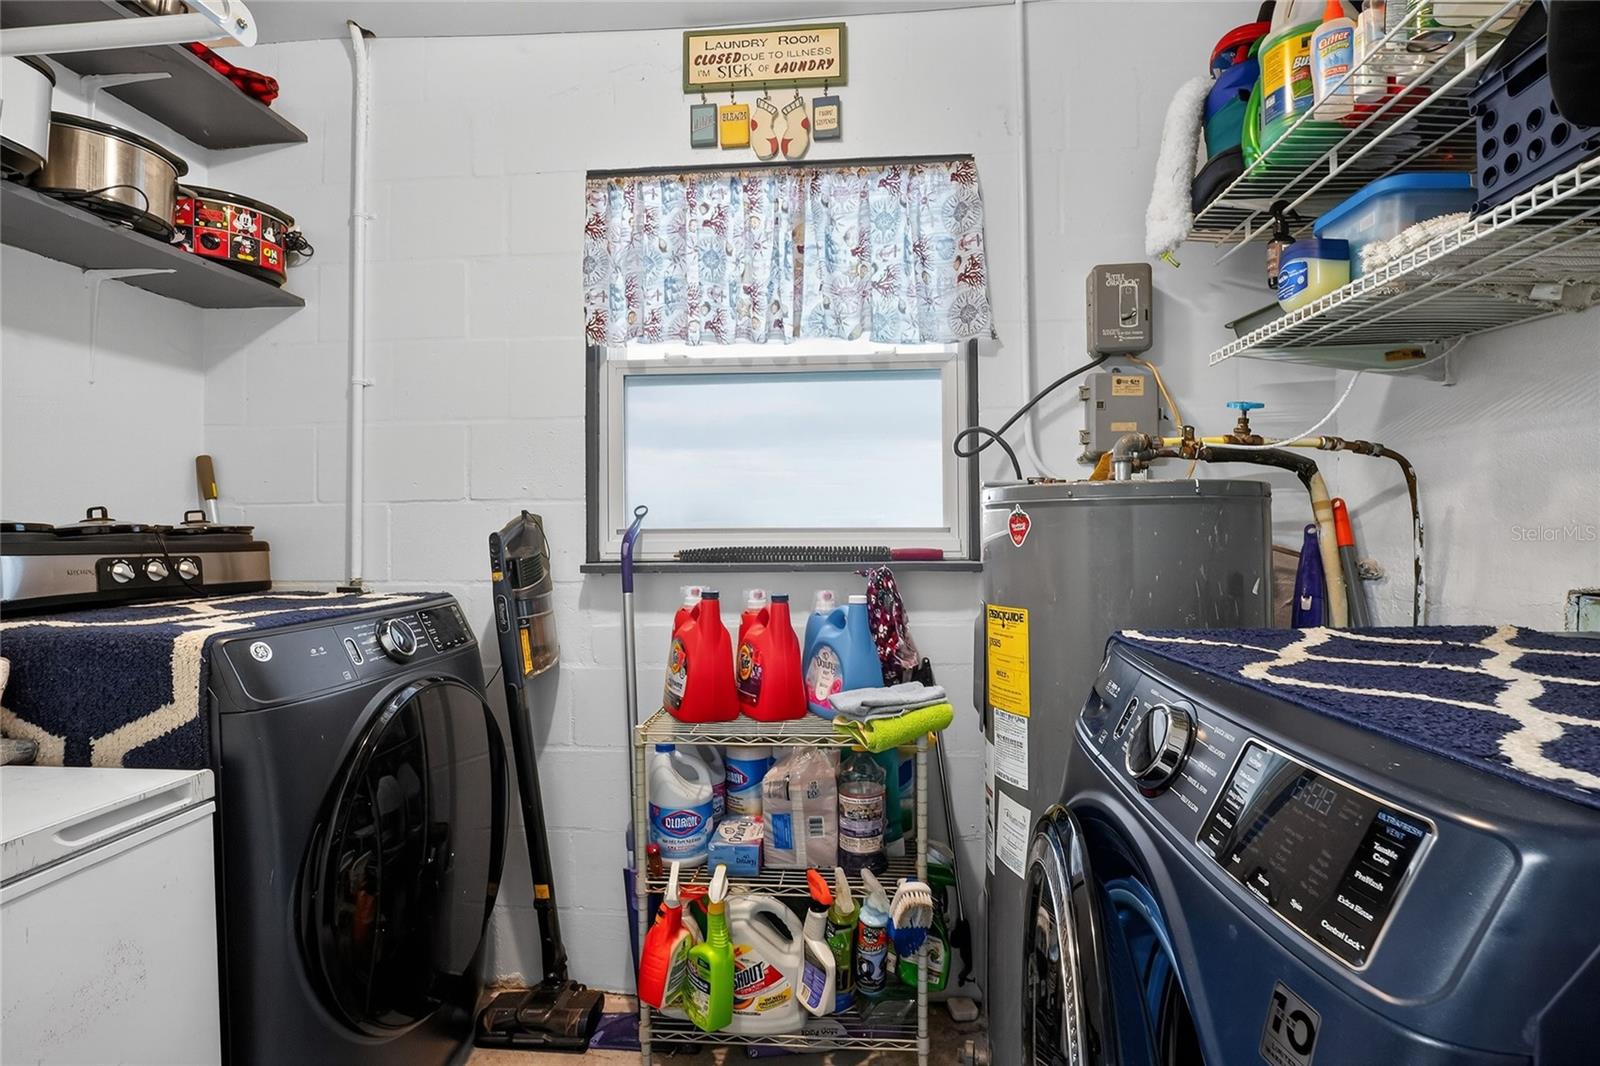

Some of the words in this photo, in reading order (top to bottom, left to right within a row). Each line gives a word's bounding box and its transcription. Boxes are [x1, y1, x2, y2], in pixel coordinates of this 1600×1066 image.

[705, 38, 768, 51] LAUNDRY
[778, 34, 820, 46] ROOM
[694, 52, 742, 66] CLOSED
[742, 52, 765, 62] DUE
[769, 51, 783, 59] TO
[786, 47, 832, 58] ILLNESS
[717, 63, 754, 79] SICK
[758, 64, 770, 73] OF
[774, 58, 834, 74] LAUNDRY
[1386, 827, 1406, 840] VENT
[1337, 894, 1355, 910] Extra
[1321, 919, 1345, 940] Control
[1343, 934, 1361, 951] Lock
[1272, 990, 1316, 1056] 10
